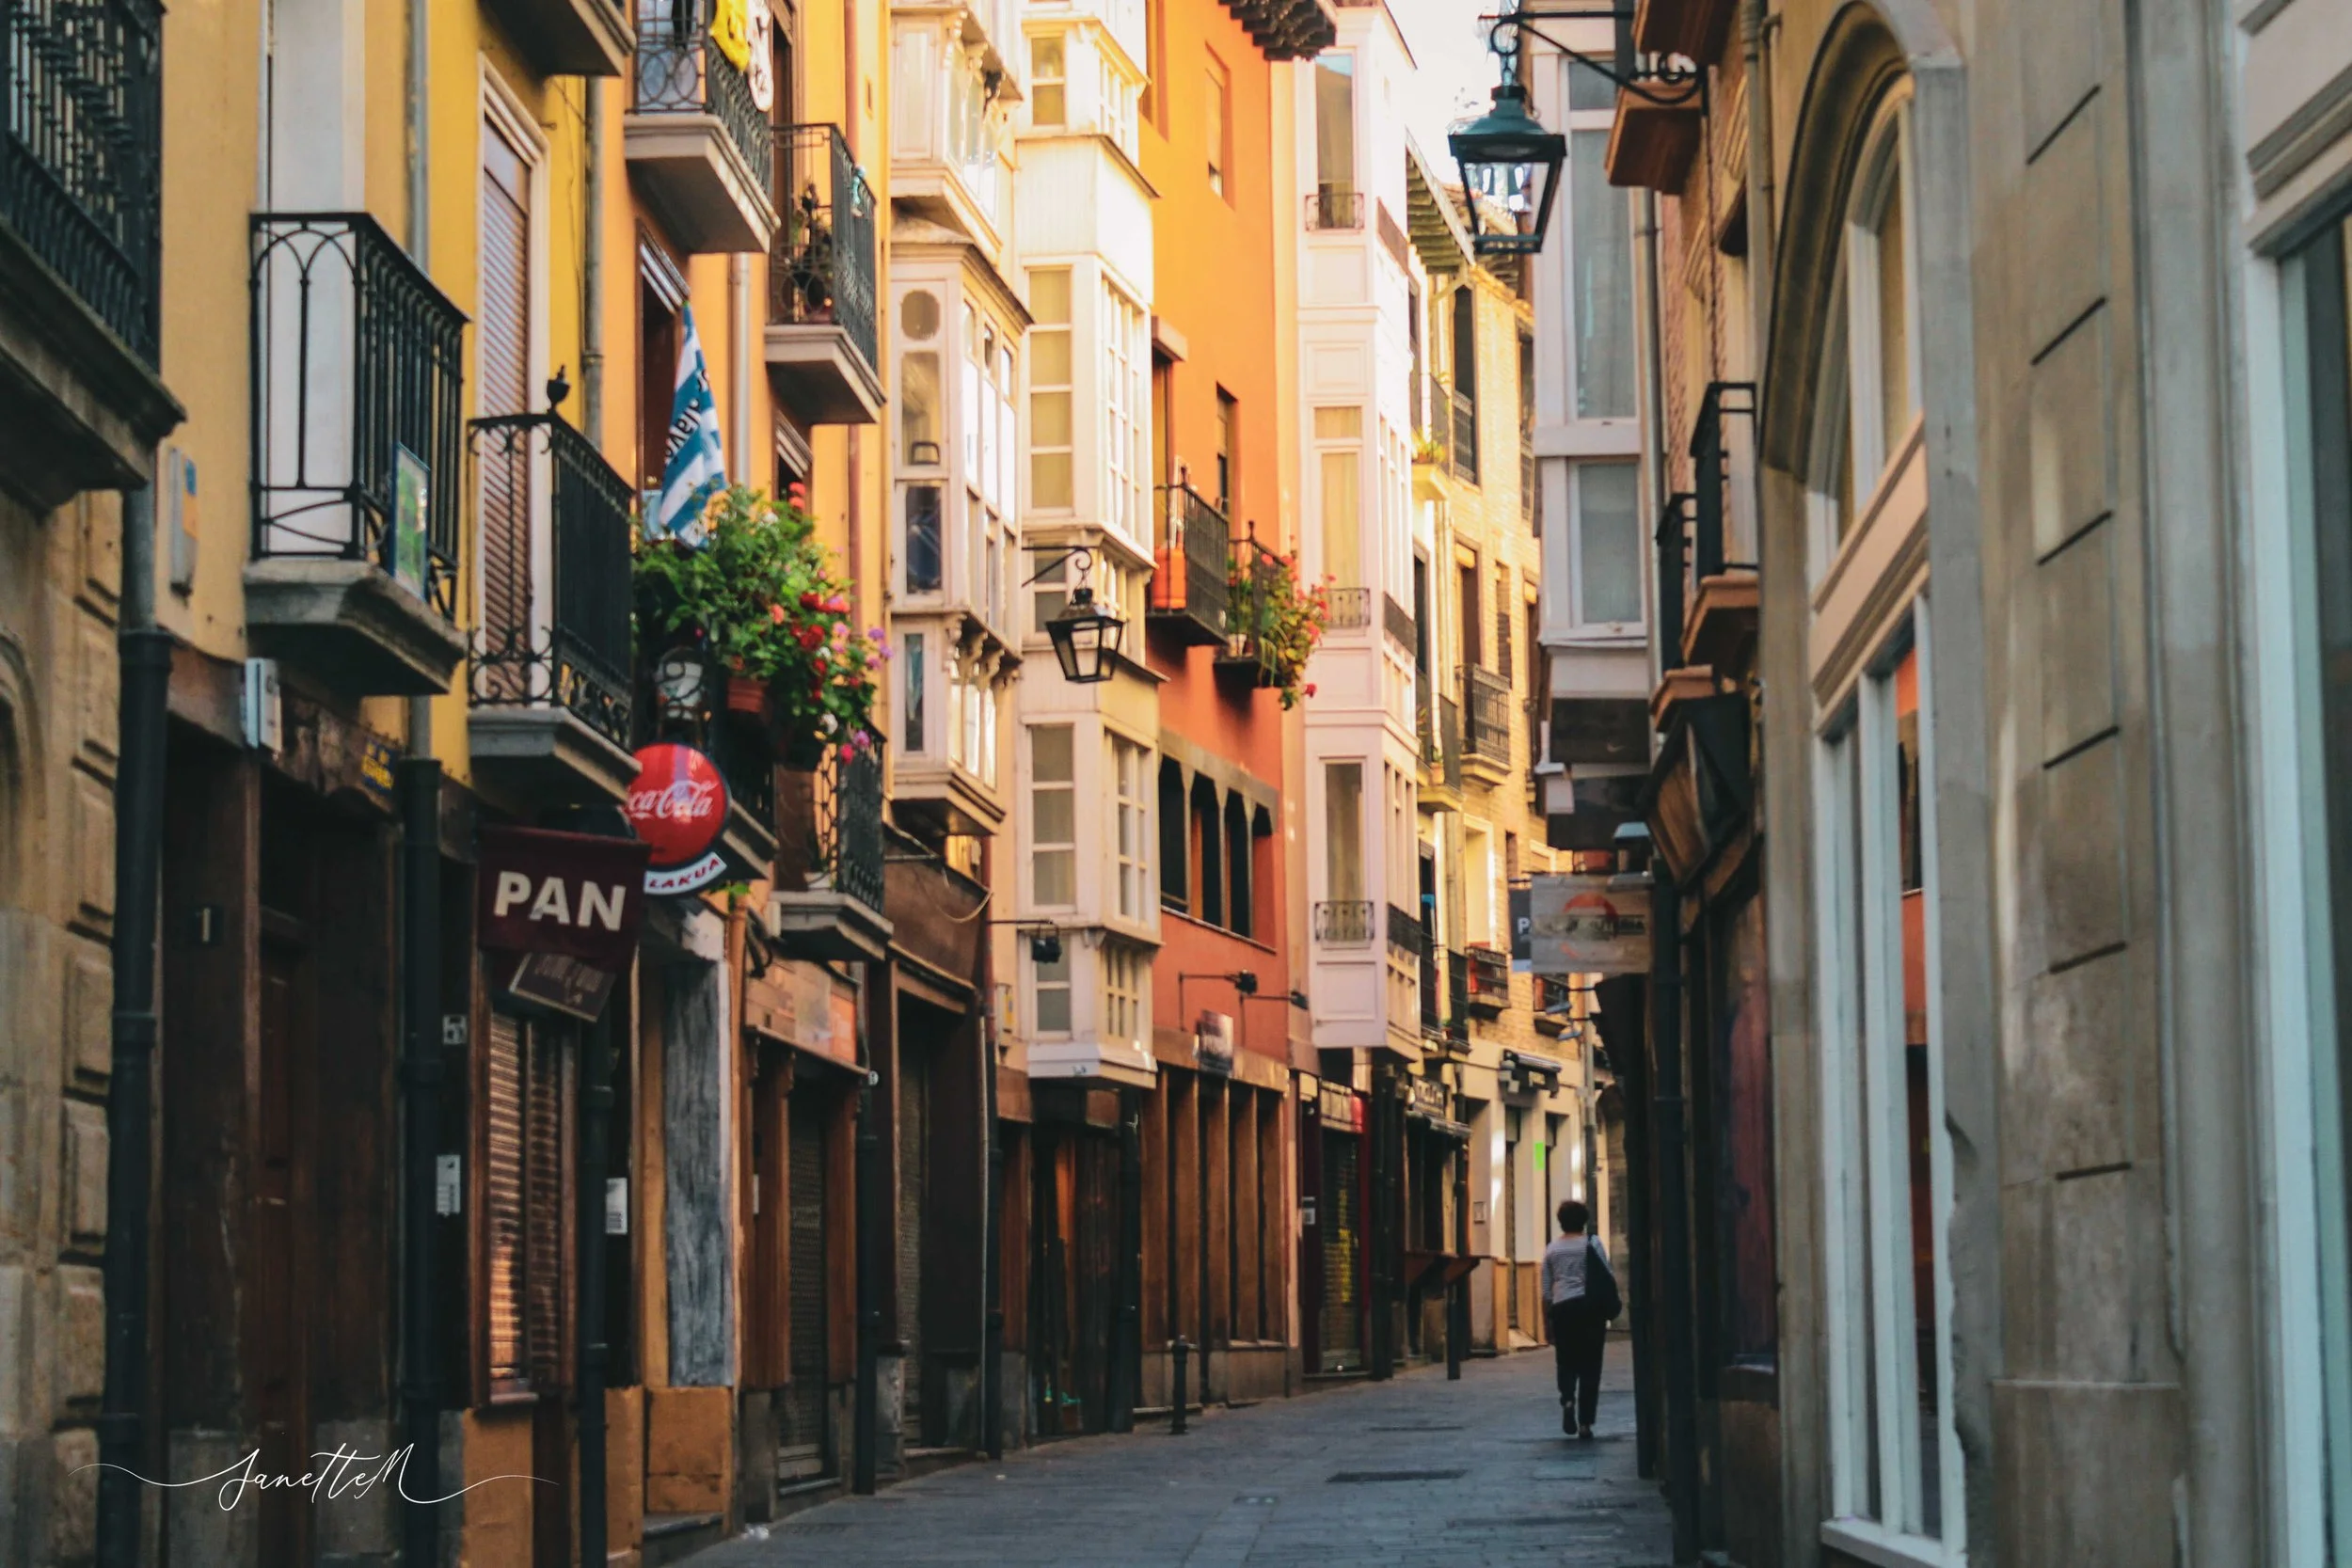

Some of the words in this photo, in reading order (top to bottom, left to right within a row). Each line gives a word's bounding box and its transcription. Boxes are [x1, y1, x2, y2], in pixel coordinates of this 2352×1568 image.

[625, 780, 719, 818] ca-Cola
[649, 858, 720, 888] LAKUA
[494, 870, 627, 931] PAN
